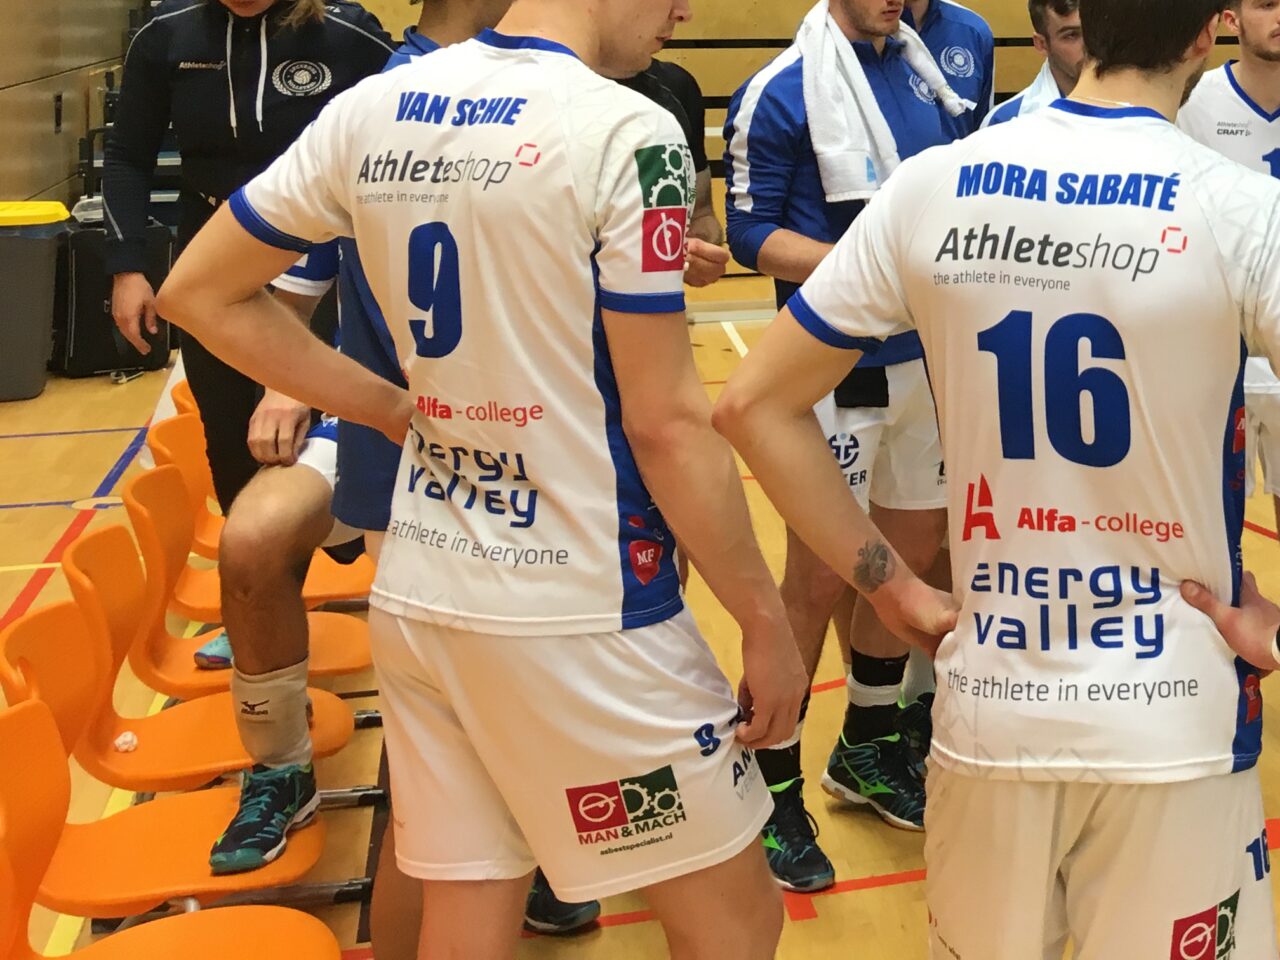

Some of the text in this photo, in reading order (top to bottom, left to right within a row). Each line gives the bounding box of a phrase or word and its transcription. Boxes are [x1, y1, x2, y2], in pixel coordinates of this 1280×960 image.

[396, 91, 528, 126] VAN SCHIE
[1217, 128, 1245, 136] CRAFT
[357, 150, 512, 190] Athleteshop
[956, 162, 1181, 212] MORA SABATÉ
[396, 190, 408, 202] in
[935, 223, 1160, 282] Athleteshop
[408, 221, 462, 358] 9
[933, 271, 1071, 291] the athlete in everyone
[977, 309, 1131, 468] 16
[392, 519, 447, 549] athlete
[450, 531, 468, 554] in
[472, 541, 569, 568] everyone
[637, 548, 655, 565] MF
[970, 562, 1162, 609] energy
[973, 604, 1164, 659] valley
[947, 669, 1198, 705] the athlete in everyone
[578, 810, 687, 845] MAN & MACH
[600, 831, 673, 855] asbestspecialist.nl
